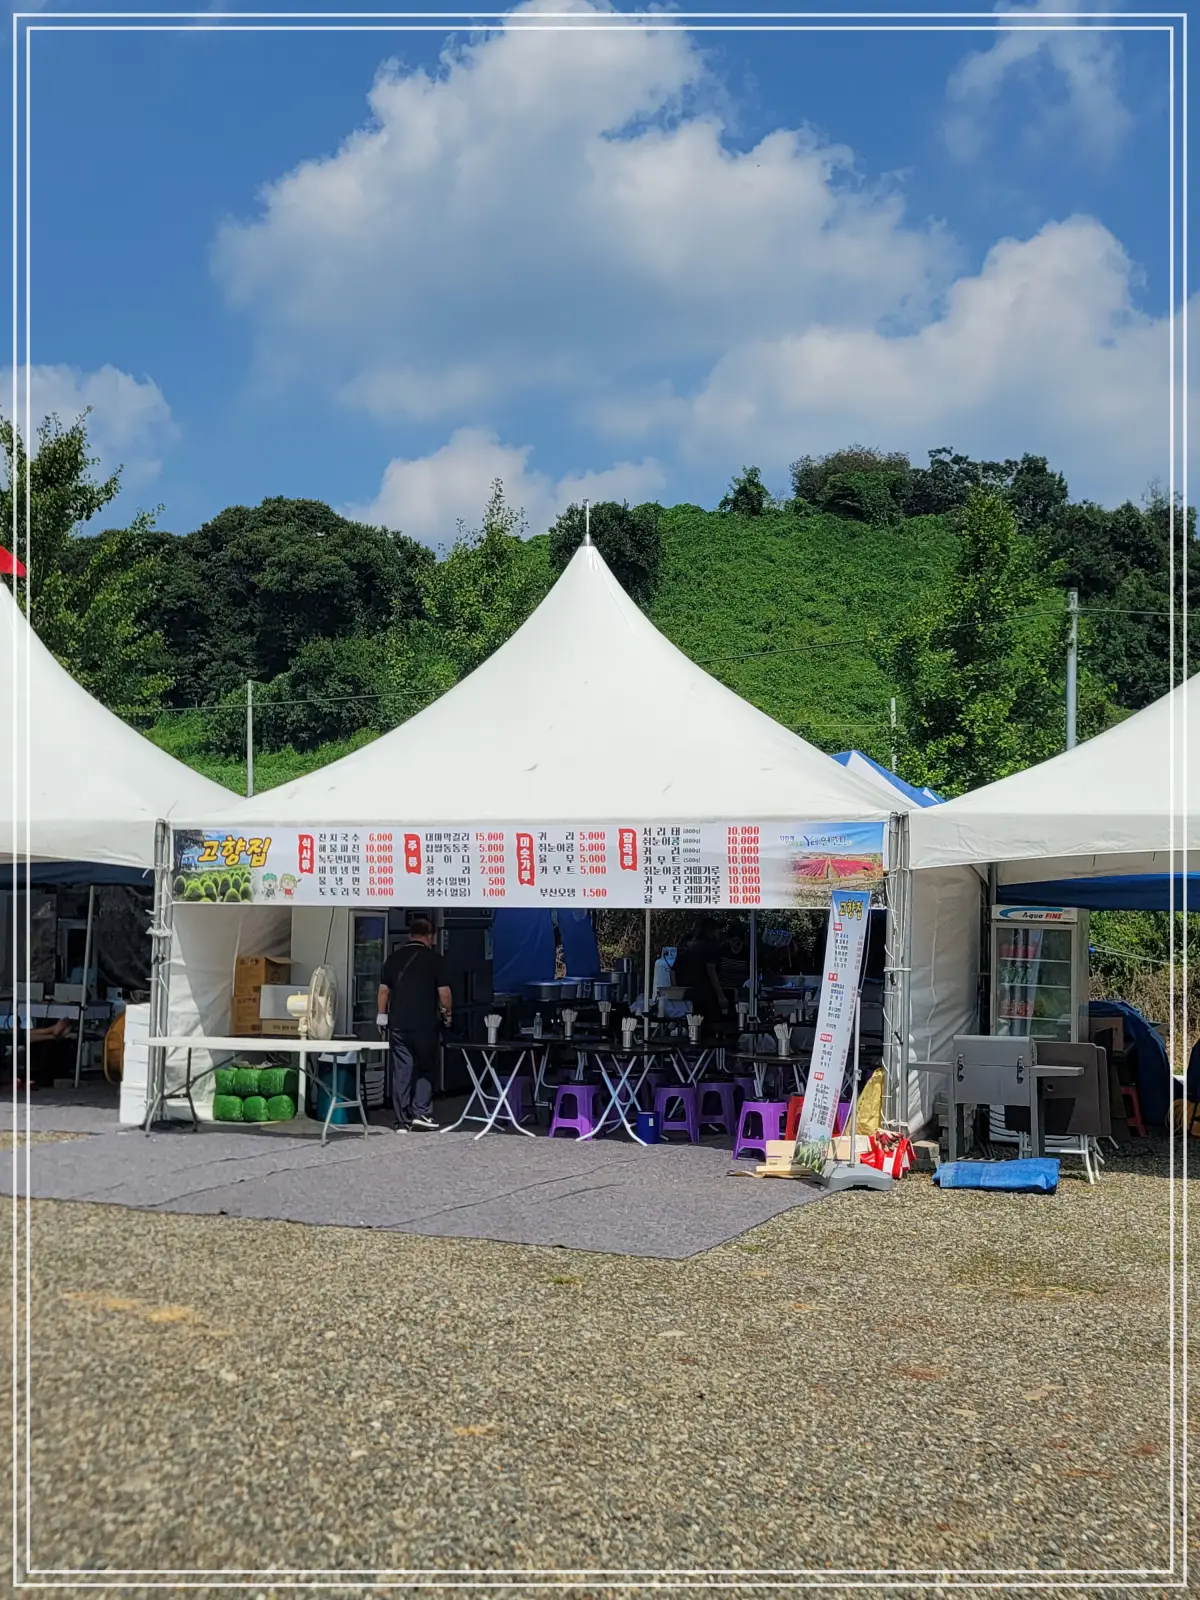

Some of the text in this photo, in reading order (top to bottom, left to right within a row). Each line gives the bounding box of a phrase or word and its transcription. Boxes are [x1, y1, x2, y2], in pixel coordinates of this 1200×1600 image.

[727, 826, 759, 835] 10,000
[319, 833, 393, 842] 잔치국수 6,000
[475, 832, 504, 842] 15,000
[579, 831, 606, 841] 5,000
[643, 836, 681, 846] 쥐눈이콩
[727, 836, 759, 845] 10,000
[198, 835, 272, 867] 고향집
[319, 844, 393, 853] 해물파전 10,000
[425, 843, 504, 853] 찹쌀동동주 5,000
[538, 843, 606, 852] 쥐눈이콩 5,000
[623, 832, 634, 866] 잡곡류
[727, 846, 759, 855] 10,000
[301, 837, 312, 870] 식사류
[365, 855, 393, 864] 10,000
[479, 855, 505, 864] 2,000
[520, 837, 531, 881] 미숫가루
[579, 854, 606, 864] 5,000
[727, 855, 759, 864] 10,000
[319, 866, 393, 875] 비빔냉면 8,000
[480, 866, 505, 875] 2,000
[580, 865, 607, 875] 5,000
[643, 865, 681, 875] 쥐눈이콩
[728, 865, 761, 875] 10,000
[369, 877, 394, 886] 8,000
[488, 876, 505, 886] 500
[728, 875, 761, 885] 10,000
[319, 887, 394, 897] 도토리묵 10,000
[482, 887, 506, 897] 1,000
[539, 887, 608, 897] 부산오뎅 1,500
[728, 885, 761, 895] 10,000
[728, 895, 761, 904] 10,000
[838, 899, 864, 920] 고향집
[1045, 912, 1062, 920] FINE
